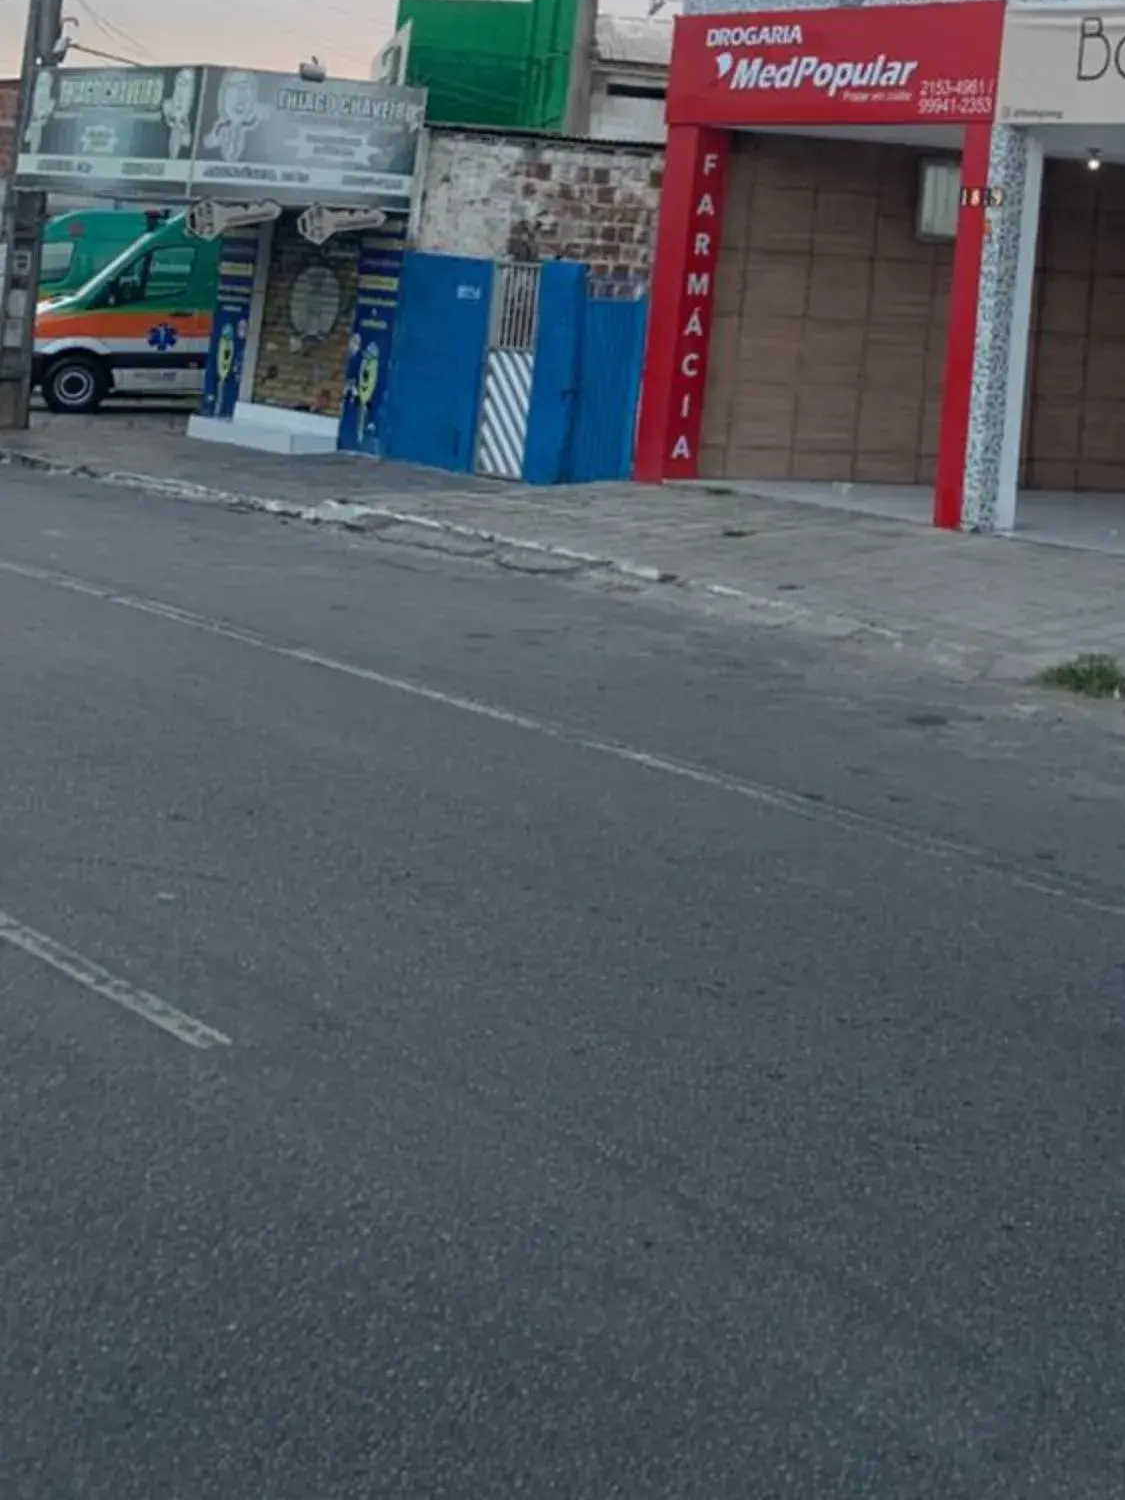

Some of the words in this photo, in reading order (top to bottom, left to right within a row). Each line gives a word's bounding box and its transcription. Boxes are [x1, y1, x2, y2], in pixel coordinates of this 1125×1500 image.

[705, 25, 803, 47] DROGARIA
[729, 52, 918, 98] MedPopular
[277, 87, 337, 114] THIAGO
[671, 153, 719, 460] FARMÁCIA
